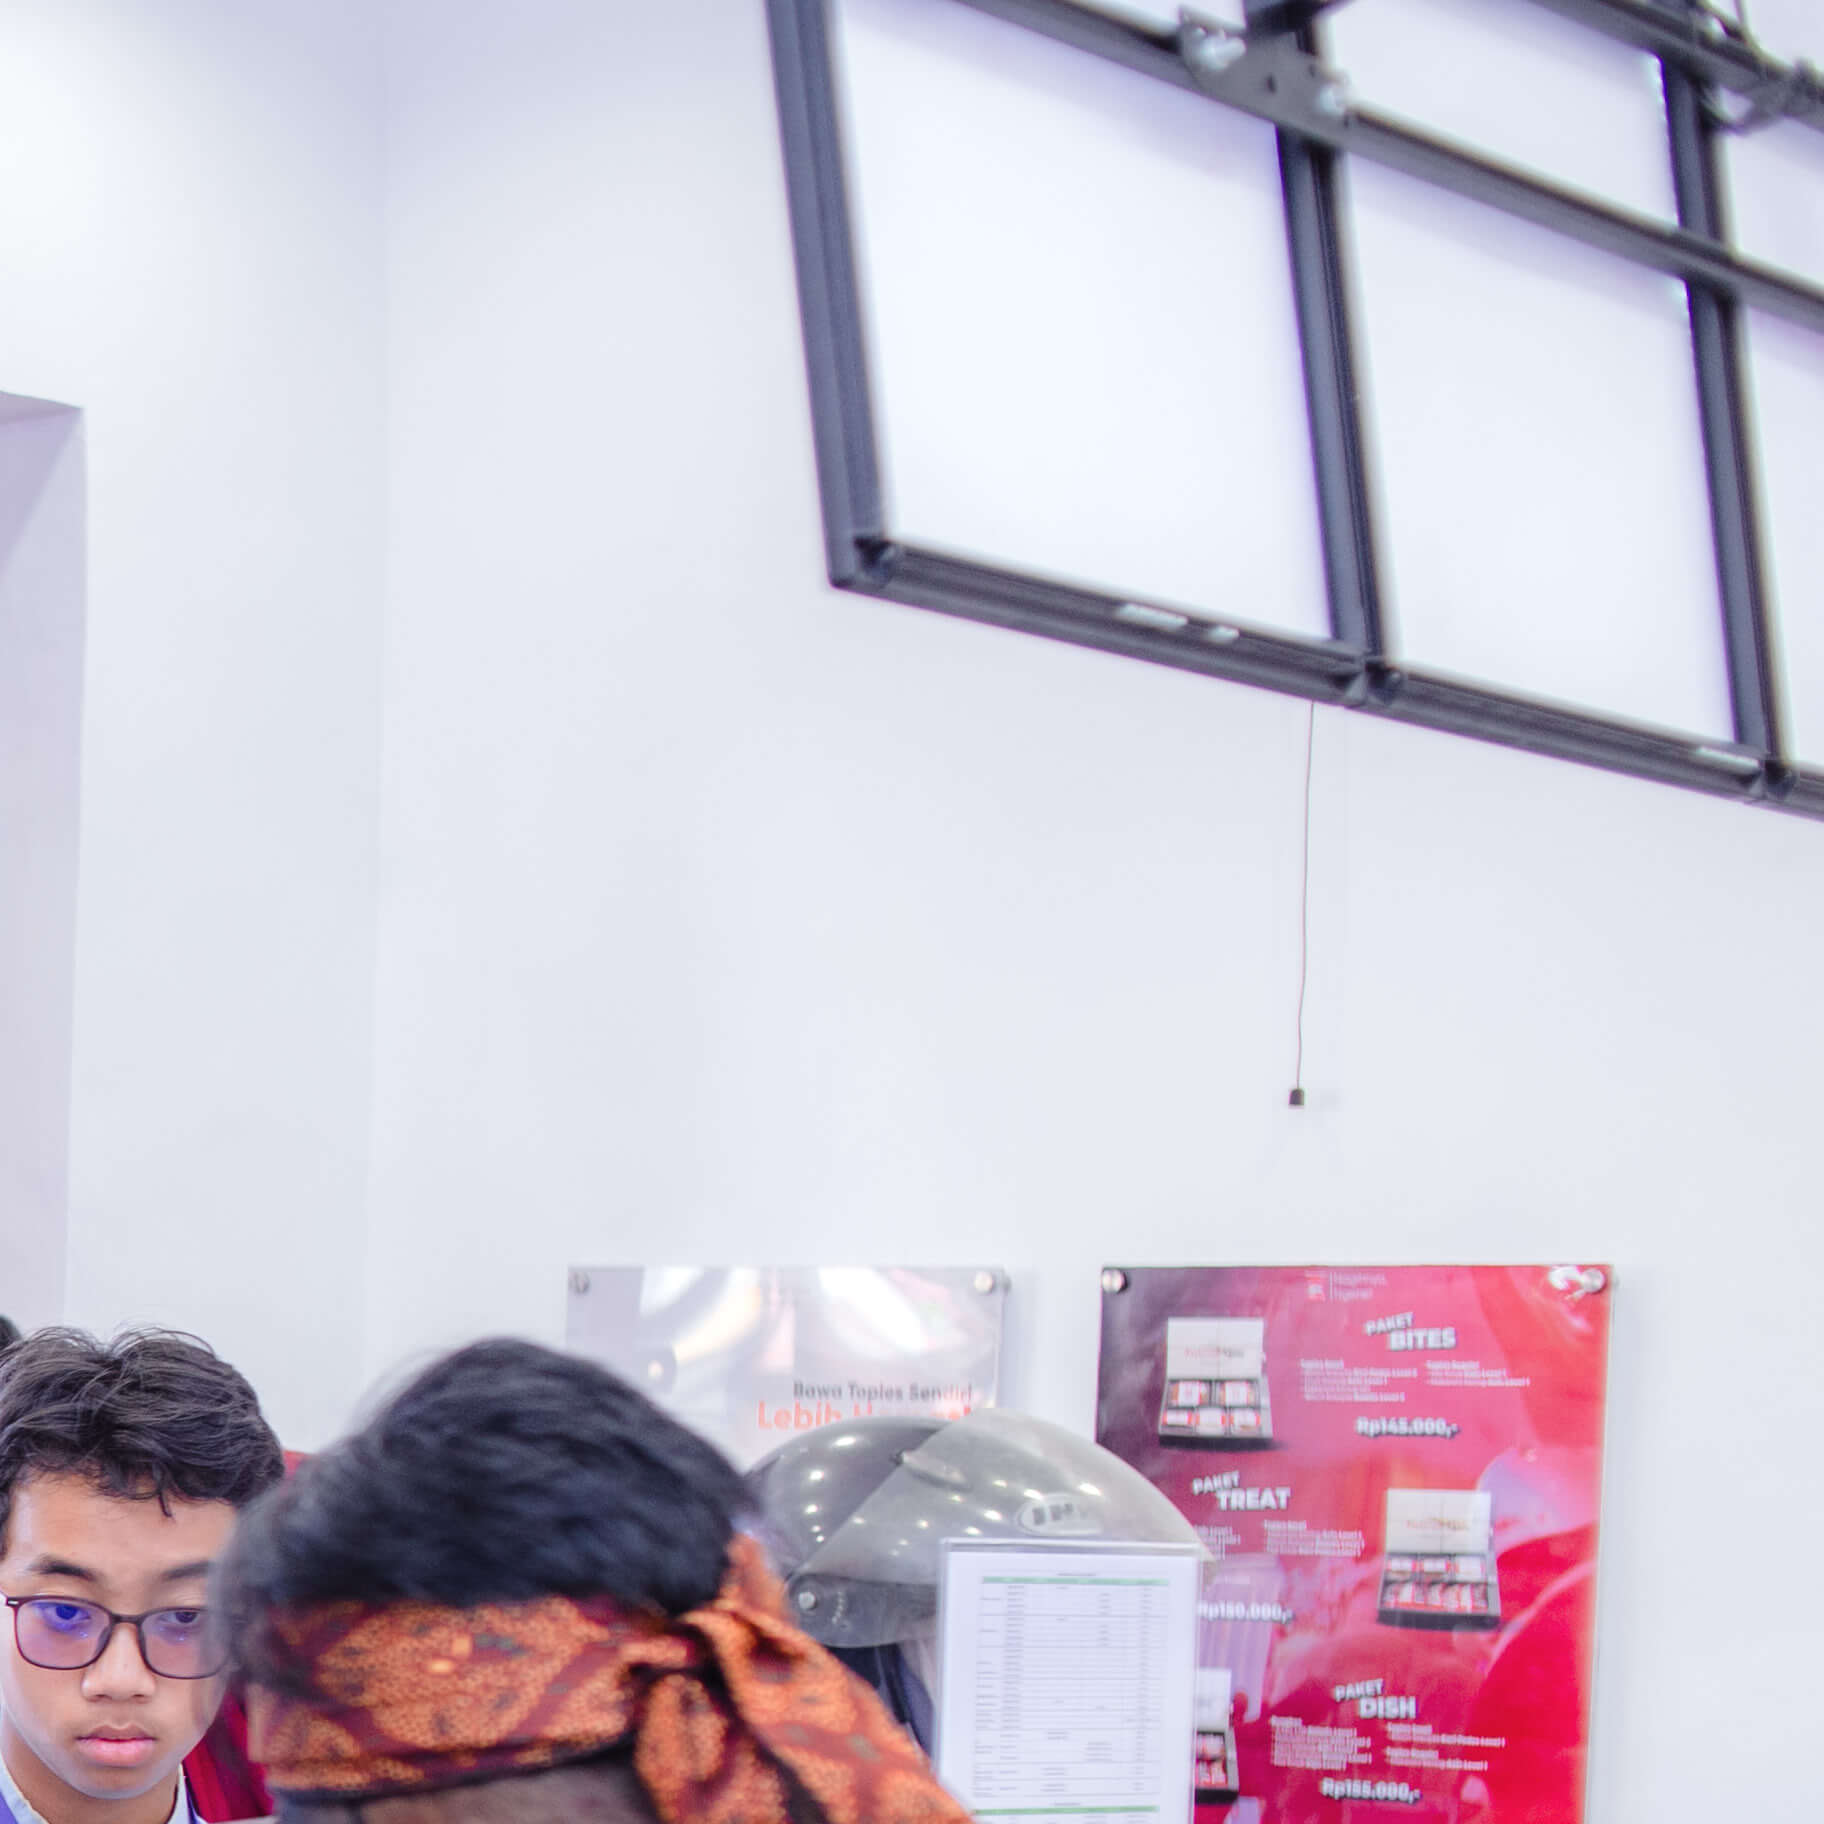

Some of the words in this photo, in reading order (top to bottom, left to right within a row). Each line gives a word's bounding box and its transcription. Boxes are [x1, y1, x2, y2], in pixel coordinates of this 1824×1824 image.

[1365, 1312, 1414, 1336] PAKET
[1388, 1327, 1456, 1350] BITES
[1192, 1471, 1240, 1495] PAKET
[1216, 1487, 1291, 1510] TREAT
[1335, 1678, 1384, 1702] PAKET
[1359, 1696, 1417, 1719] DISH
